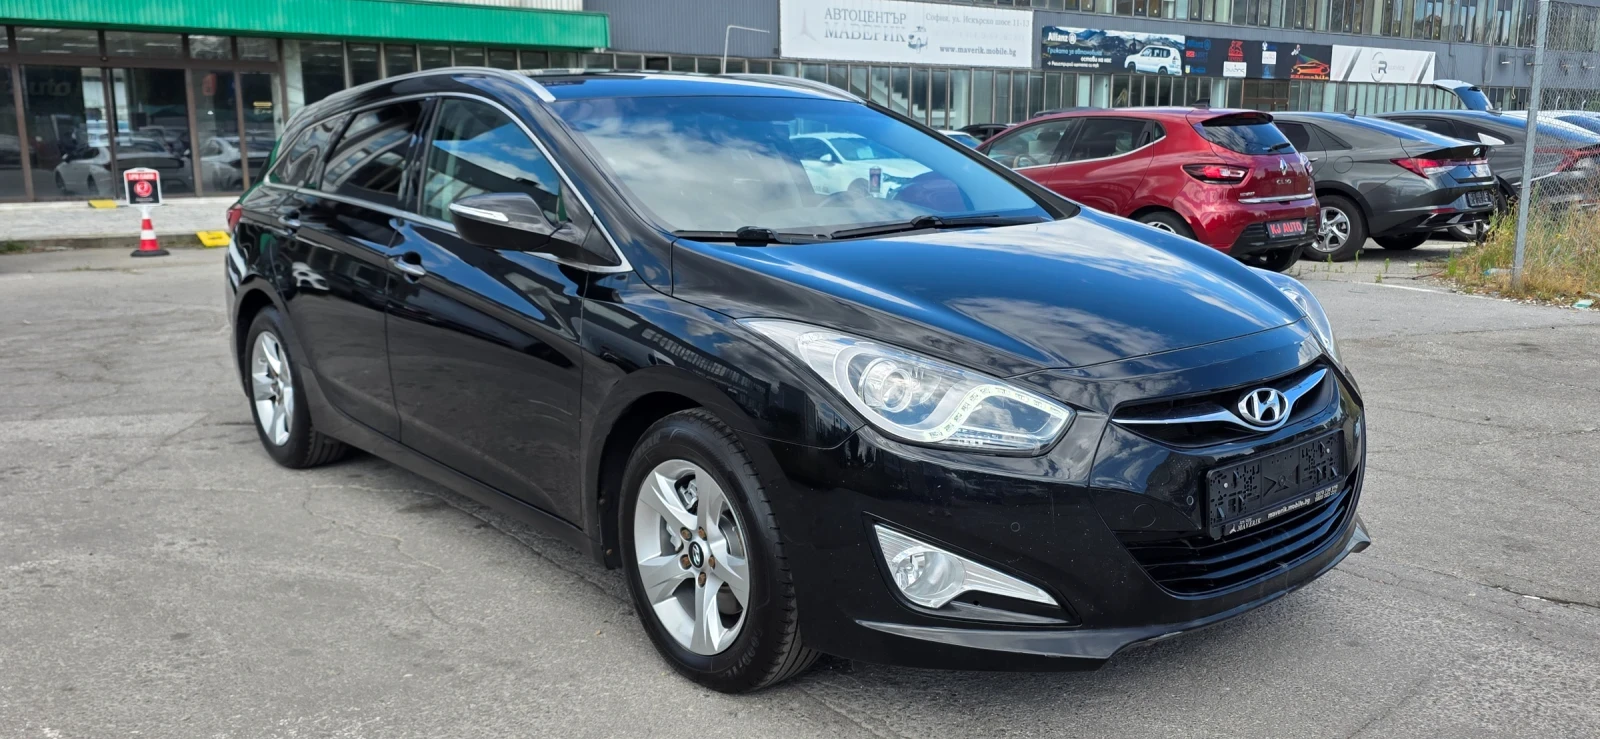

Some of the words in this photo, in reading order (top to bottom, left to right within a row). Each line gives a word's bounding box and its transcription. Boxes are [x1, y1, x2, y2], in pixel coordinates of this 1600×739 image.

[824, 7, 907, 24] АВТОЦЕНТЪР
[925, 13, 950, 23] София,
[952, 16, 961, 25] ул.
[963, 16, 993, 26] Искърско
[824, 21, 906, 42] МАВЕРИК
[1048, 32, 1068, 42] Allianz
[939, 46, 1017, 57] www.maverik.mobile.bg
[1270, 223, 1281, 234] KJ
[1283, 221, 1302, 233] AUTO
[1268, 498, 1310, 519] maverik.mobile.bg
